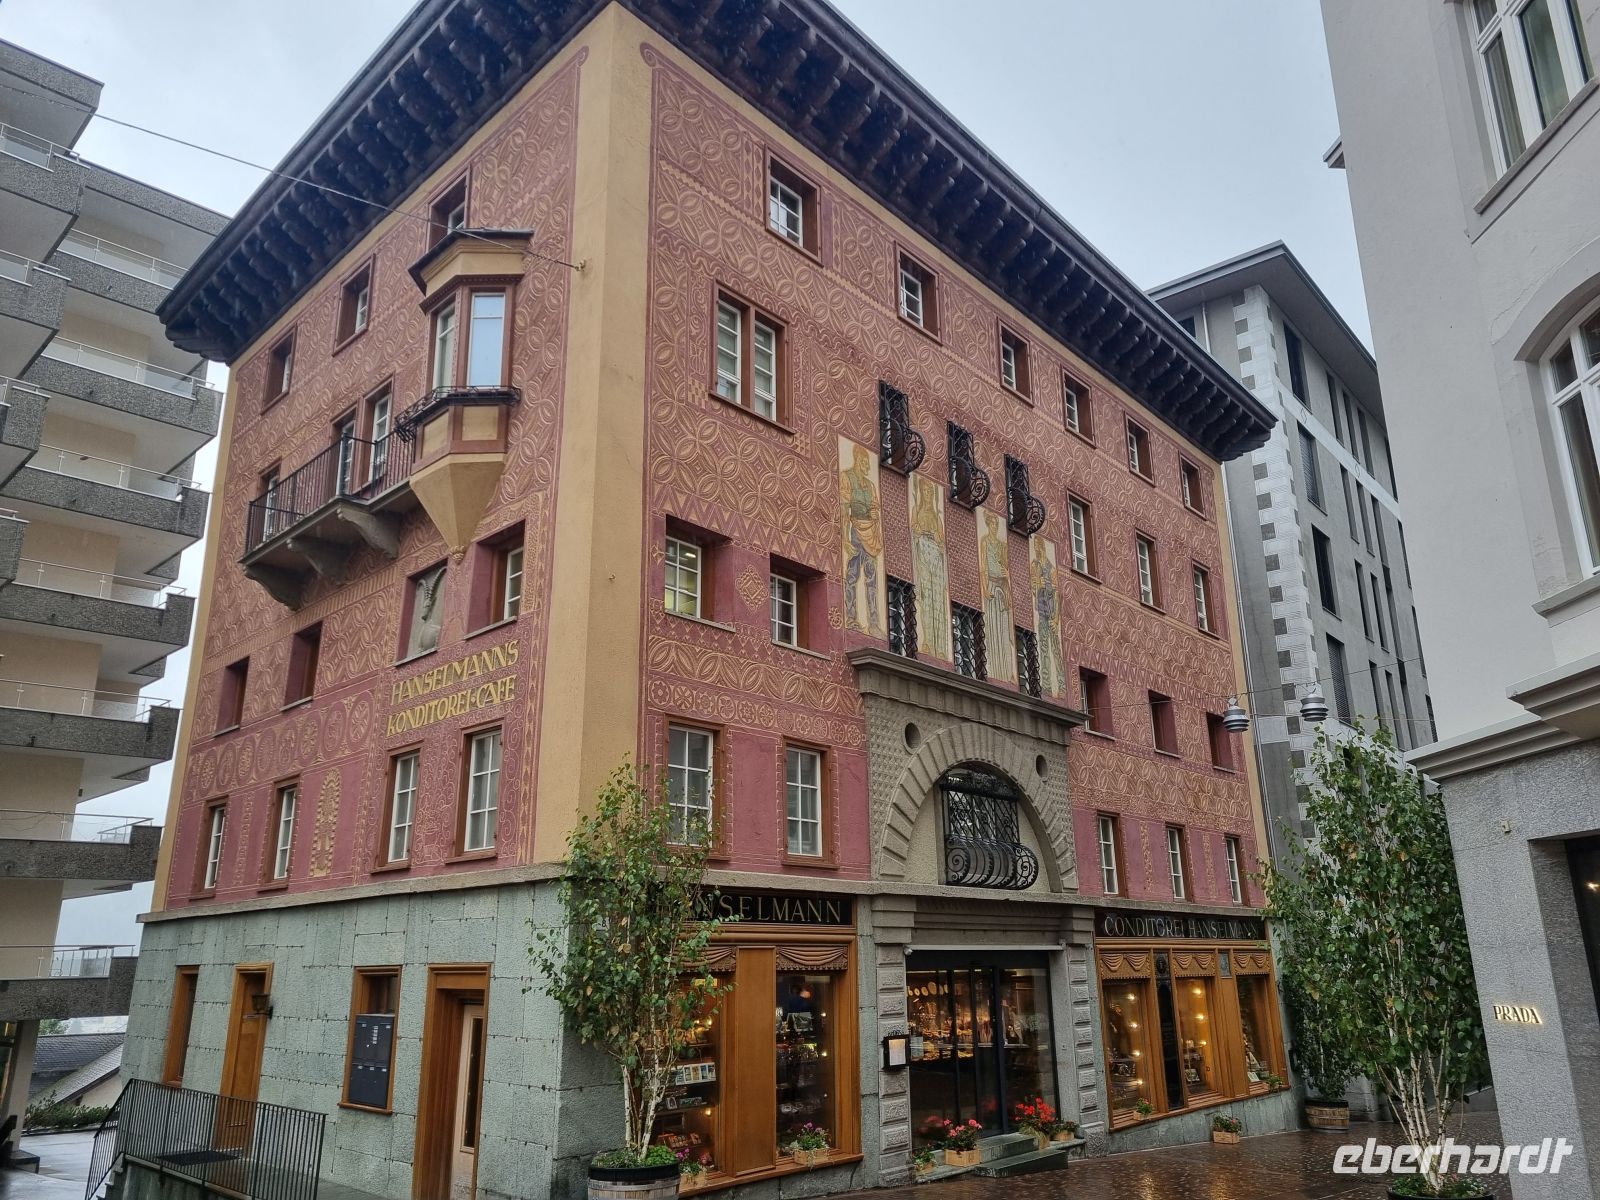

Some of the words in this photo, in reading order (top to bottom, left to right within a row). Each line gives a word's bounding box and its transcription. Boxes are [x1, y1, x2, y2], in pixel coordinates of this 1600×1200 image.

[390, 639, 519, 706] HANSELMANNS
[687, 891, 842, 923] NSELMANN
[1104, 915, 1185, 938] CONDITOREI
[1493, 1005, 1541, 1024] PRADA
